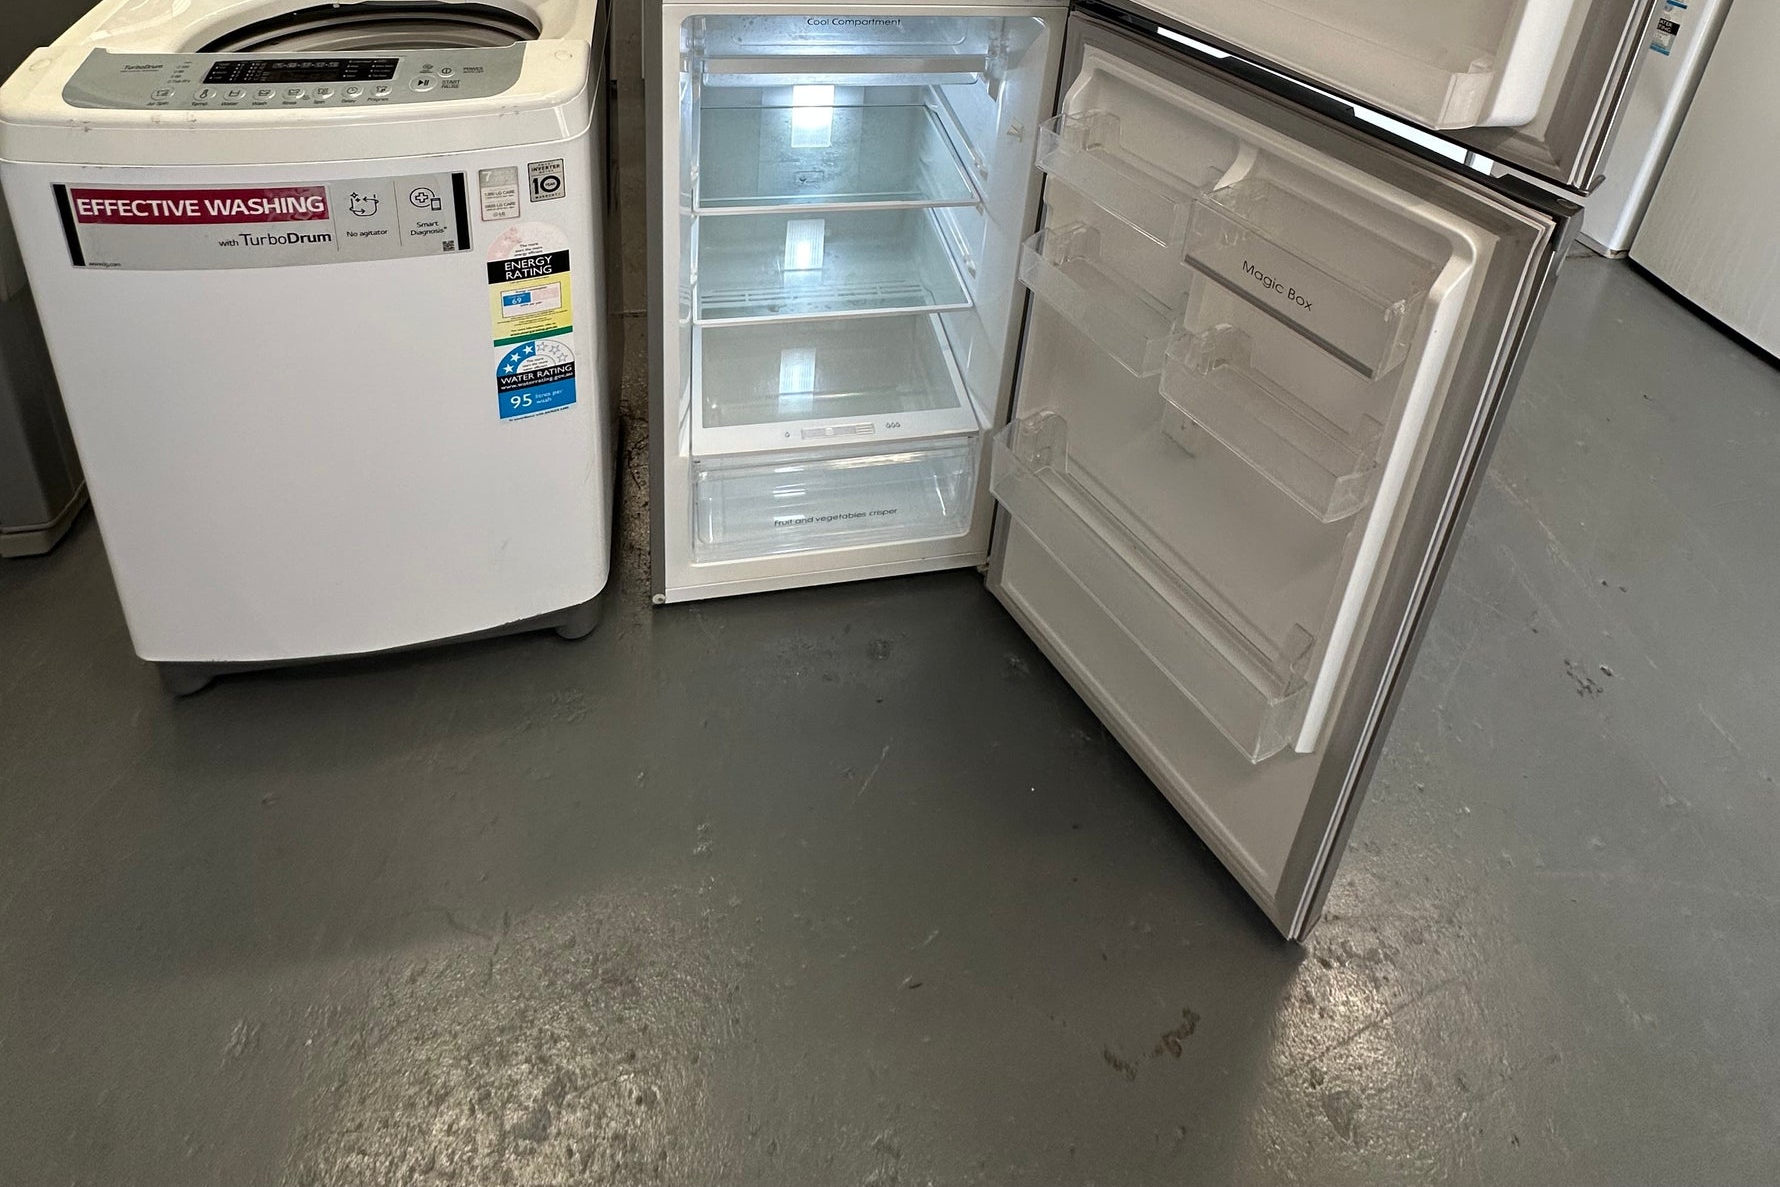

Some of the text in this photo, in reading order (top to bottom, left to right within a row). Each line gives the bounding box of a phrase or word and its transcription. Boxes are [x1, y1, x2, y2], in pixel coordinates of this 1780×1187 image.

[807, 17, 901, 27] Cool Compartment
[77, 196, 325, 216] EFFECTIVE WASHING
[239, 232, 332, 246] TurboDrum
[504, 255, 552, 271] ENERGY
[505, 265, 552, 280] RATING
[1242, 260, 1313, 311] Magic Box
[511, 297, 522, 305] 69
[501, 373, 535, 384] WATER
[536, 365, 573, 378] RATING
[510, 393, 533, 409] 95
[815, 512, 866, 522] vegetables
